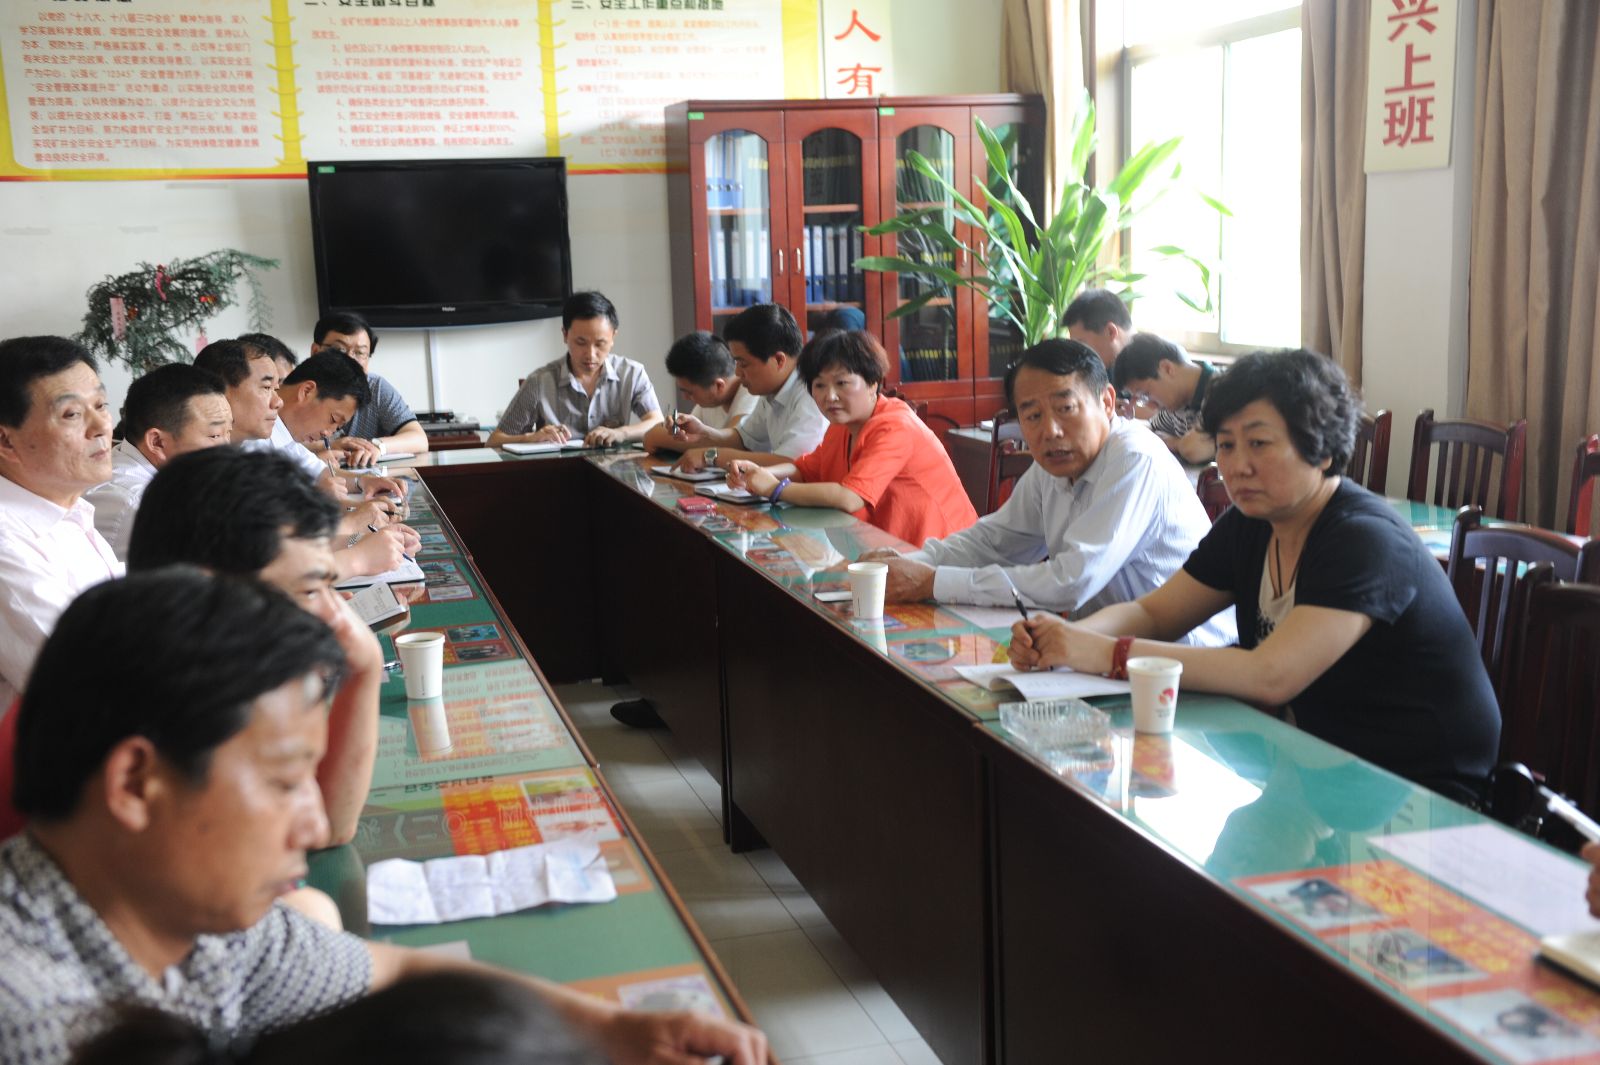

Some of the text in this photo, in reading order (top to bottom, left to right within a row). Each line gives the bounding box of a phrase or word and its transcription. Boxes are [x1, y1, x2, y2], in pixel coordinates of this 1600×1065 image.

[833, 9, 883, 96] 人有
[1382, 0, 1439, 149] 兴上班
